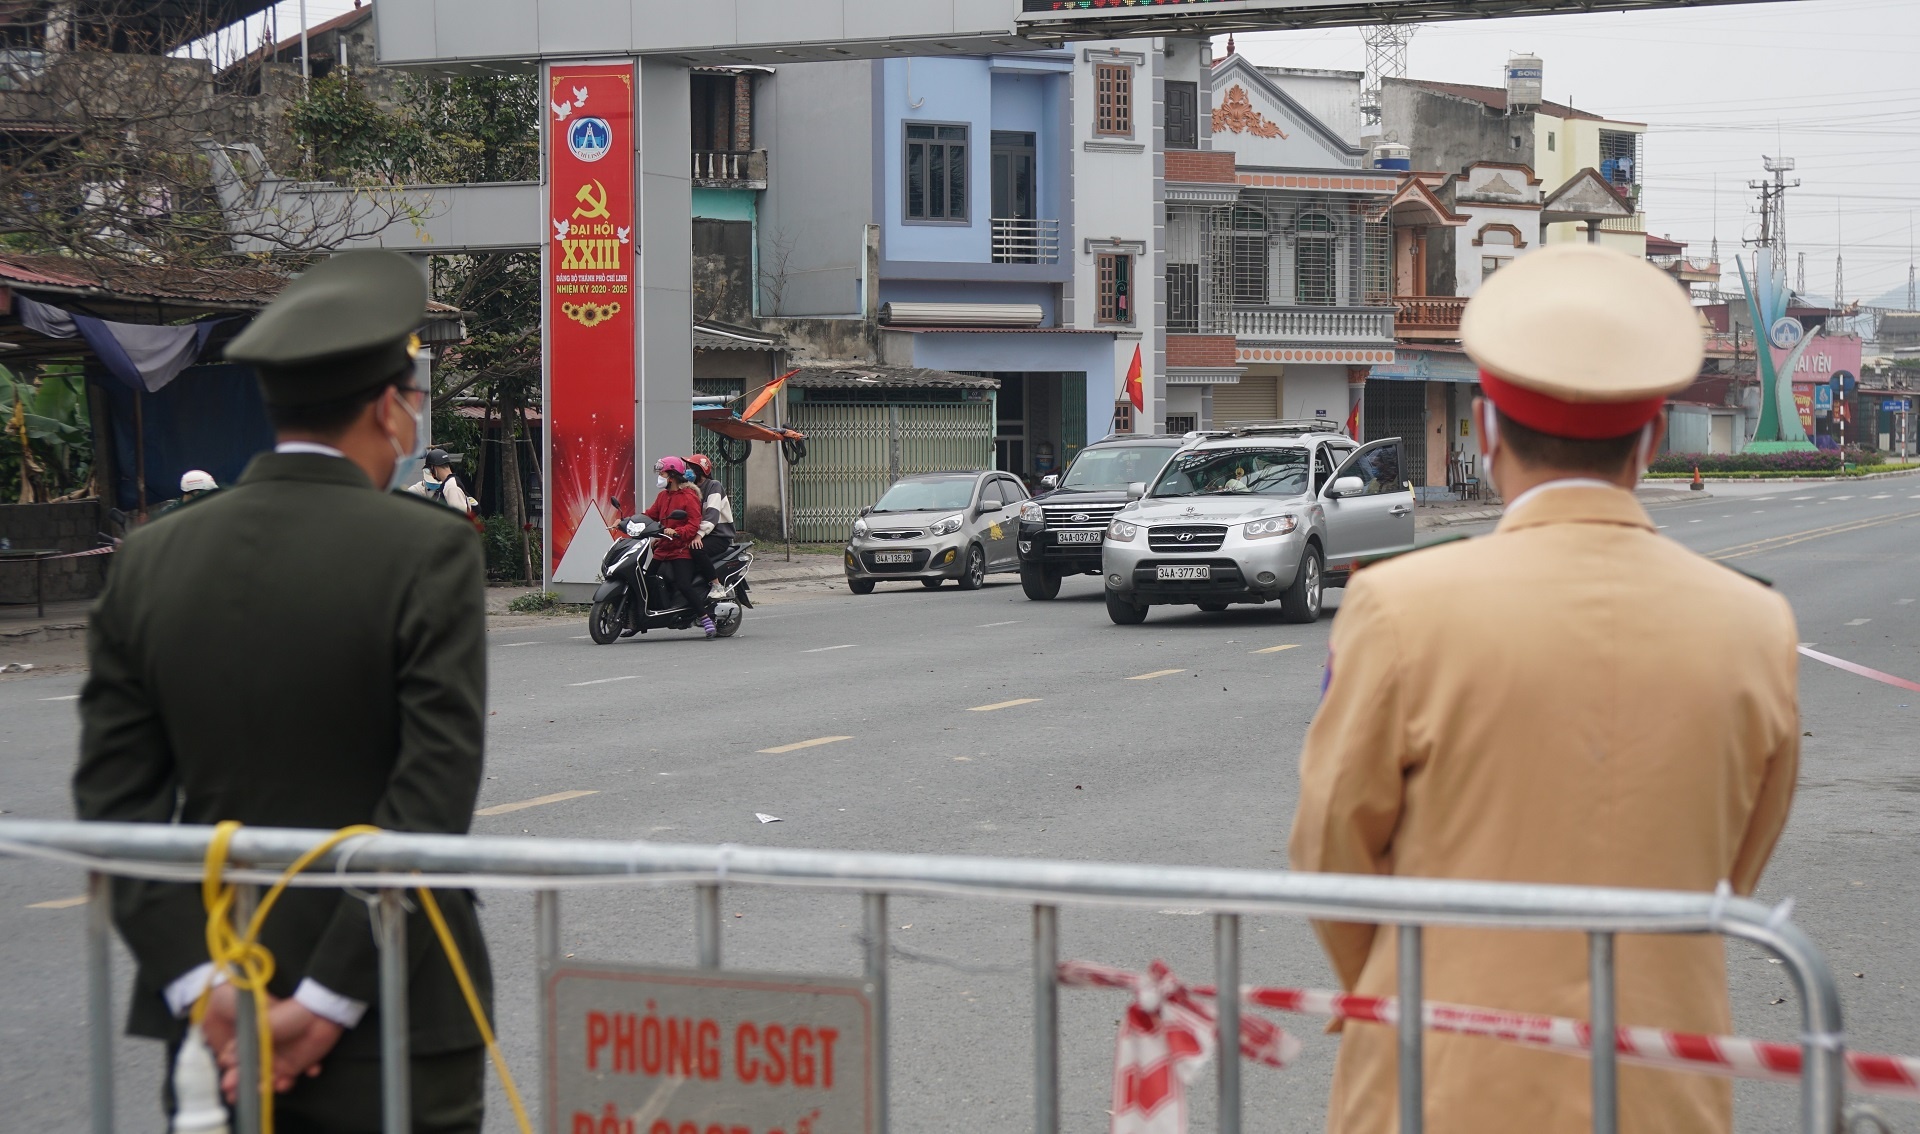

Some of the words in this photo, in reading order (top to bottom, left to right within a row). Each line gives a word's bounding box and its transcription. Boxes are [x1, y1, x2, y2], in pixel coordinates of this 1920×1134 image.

[570, 224, 590, 238] ĐẠI
[593, 220, 614, 238] HỘI
[561, 239, 620, 270] XXIII
[556, 273, 571, 282] ĐẢNG
[606, 273, 615, 282] CHÍ
[615, 274, 628, 282] LINH
[556, 282, 579, 296] NHIỆM
[580, 282, 589, 294] KỲ
[591, 285, 607, 294] 2020
[612, 285, 628, 294] 2025
[1059, 532, 1099, 543] 34A-037.62
[1159, 567, 1208, 578] 34A-377.90
[585, 997, 721, 1081] PHÒNG
[734, 1020, 840, 1090] CSGT
